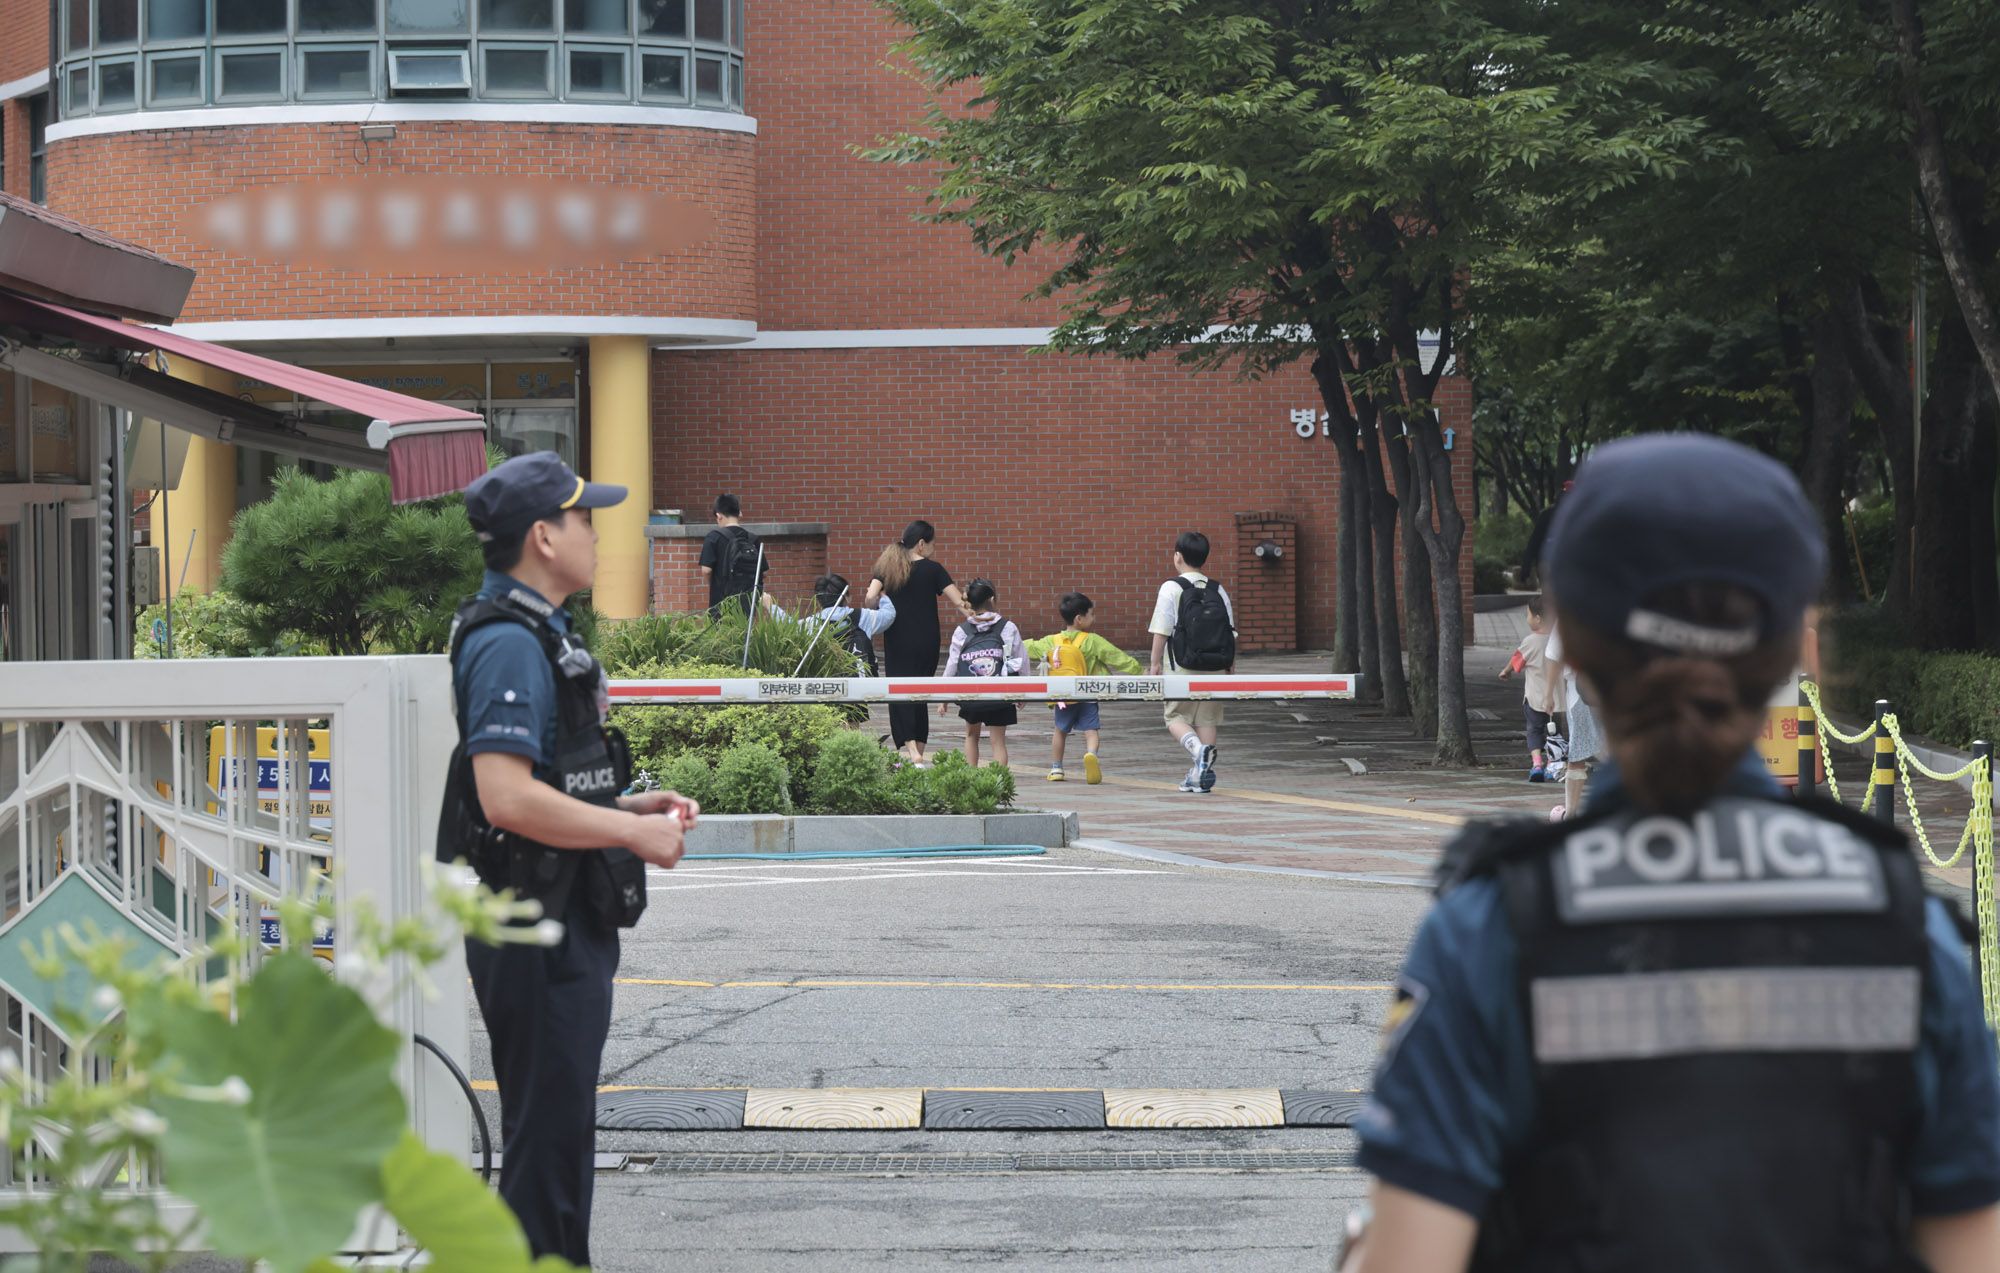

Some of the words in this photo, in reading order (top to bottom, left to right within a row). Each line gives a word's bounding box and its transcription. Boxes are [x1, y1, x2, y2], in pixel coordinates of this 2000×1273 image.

[761, 683, 801, 696] 외부차량
[805, 682, 845, 695] 출입금지
[1077, 681, 1111, 694] 자전거
[1116, 681, 1161, 694] 출입금지
[565, 767, 616, 793] POLICE
[1567, 812, 1866, 887] POLICE
